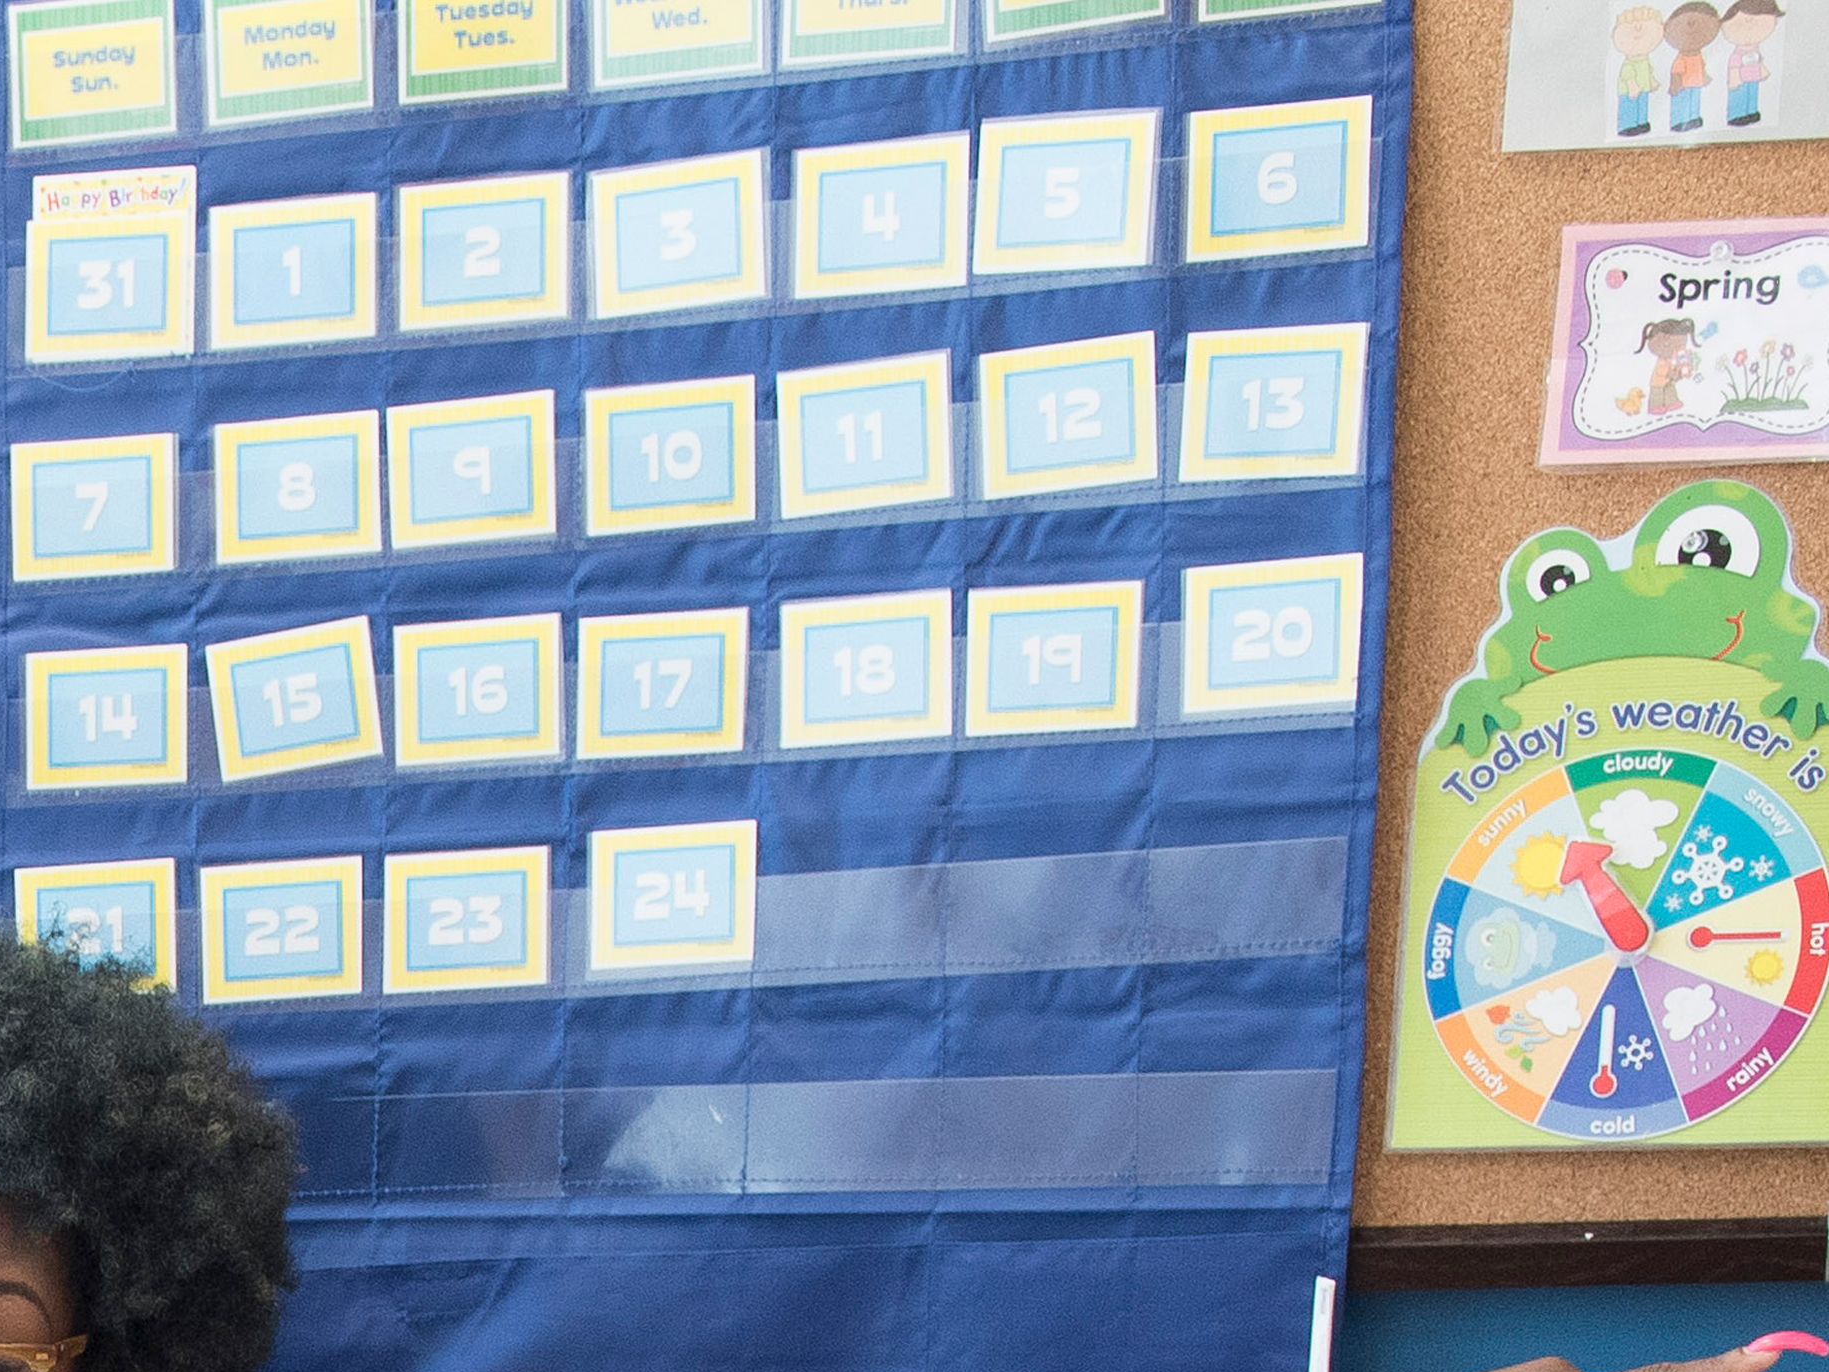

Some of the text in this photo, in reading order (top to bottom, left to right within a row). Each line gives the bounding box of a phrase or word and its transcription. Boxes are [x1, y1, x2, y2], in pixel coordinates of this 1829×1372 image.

[243, 19, 336, 46] Monday
[434, 0, 534, 23] Tuesday
[651, 8, 709, 30] Wed.
[52, 44, 136, 69] Sunday
[262, 48, 320, 71] Mon.
[453, 29, 516, 49] Tues.
[71, 74, 119, 94] Sun.
[47, 177, 187, 211] Hapy Birhday!
[1043, 166, 1082, 219] 5
[1256, 151, 1298, 205] 6
[658, 208, 698, 262] 3
[862, 192, 900, 242] 4
[281, 245, 302, 297] 1
[462, 226, 502, 279] 2
[76, 257, 136, 312] 31
[1658, 269, 1781, 309] Spring
[1038, 387, 1104, 446] 12
[1241, 374, 1306, 433] 13
[641, 429, 703, 484] 10
[835, 409, 884, 464] 11
[276, 462, 317, 511] 8
[452, 445, 492, 496] 9
[74, 481, 110, 532] 7
[1021, 632, 1084, 686] 19
[1230, 604, 1314, 664] 20
[448, 664, 510, 717] 16
[633, 658, 694, 711] 17
[833, 643, 897, 697] 18
[77, 692, 138, 743] 14
[262, 672, 323, 728] 15
[1442, 700, 1828, 807] Today's weather is
[1602, 750, 1674, 778] cloudy
[1474, 797, 1530, 849] sunny
[1742, 784, 1795, 840] snowy
[428, 893, 506, 947] 23
[633, 867, 711, 922] 24
[65, 904, 125, 956] 21
[243, 904, 323, 959] 22
[1425, 921, 1455, 981] foggy
[1809, 921, 1829, 956] hot
[1462, 1045, 1507, 1099] windy
[1725, 1051, 1775, 1092] rainy
[1589, 1115, 1637, 1136] cold
